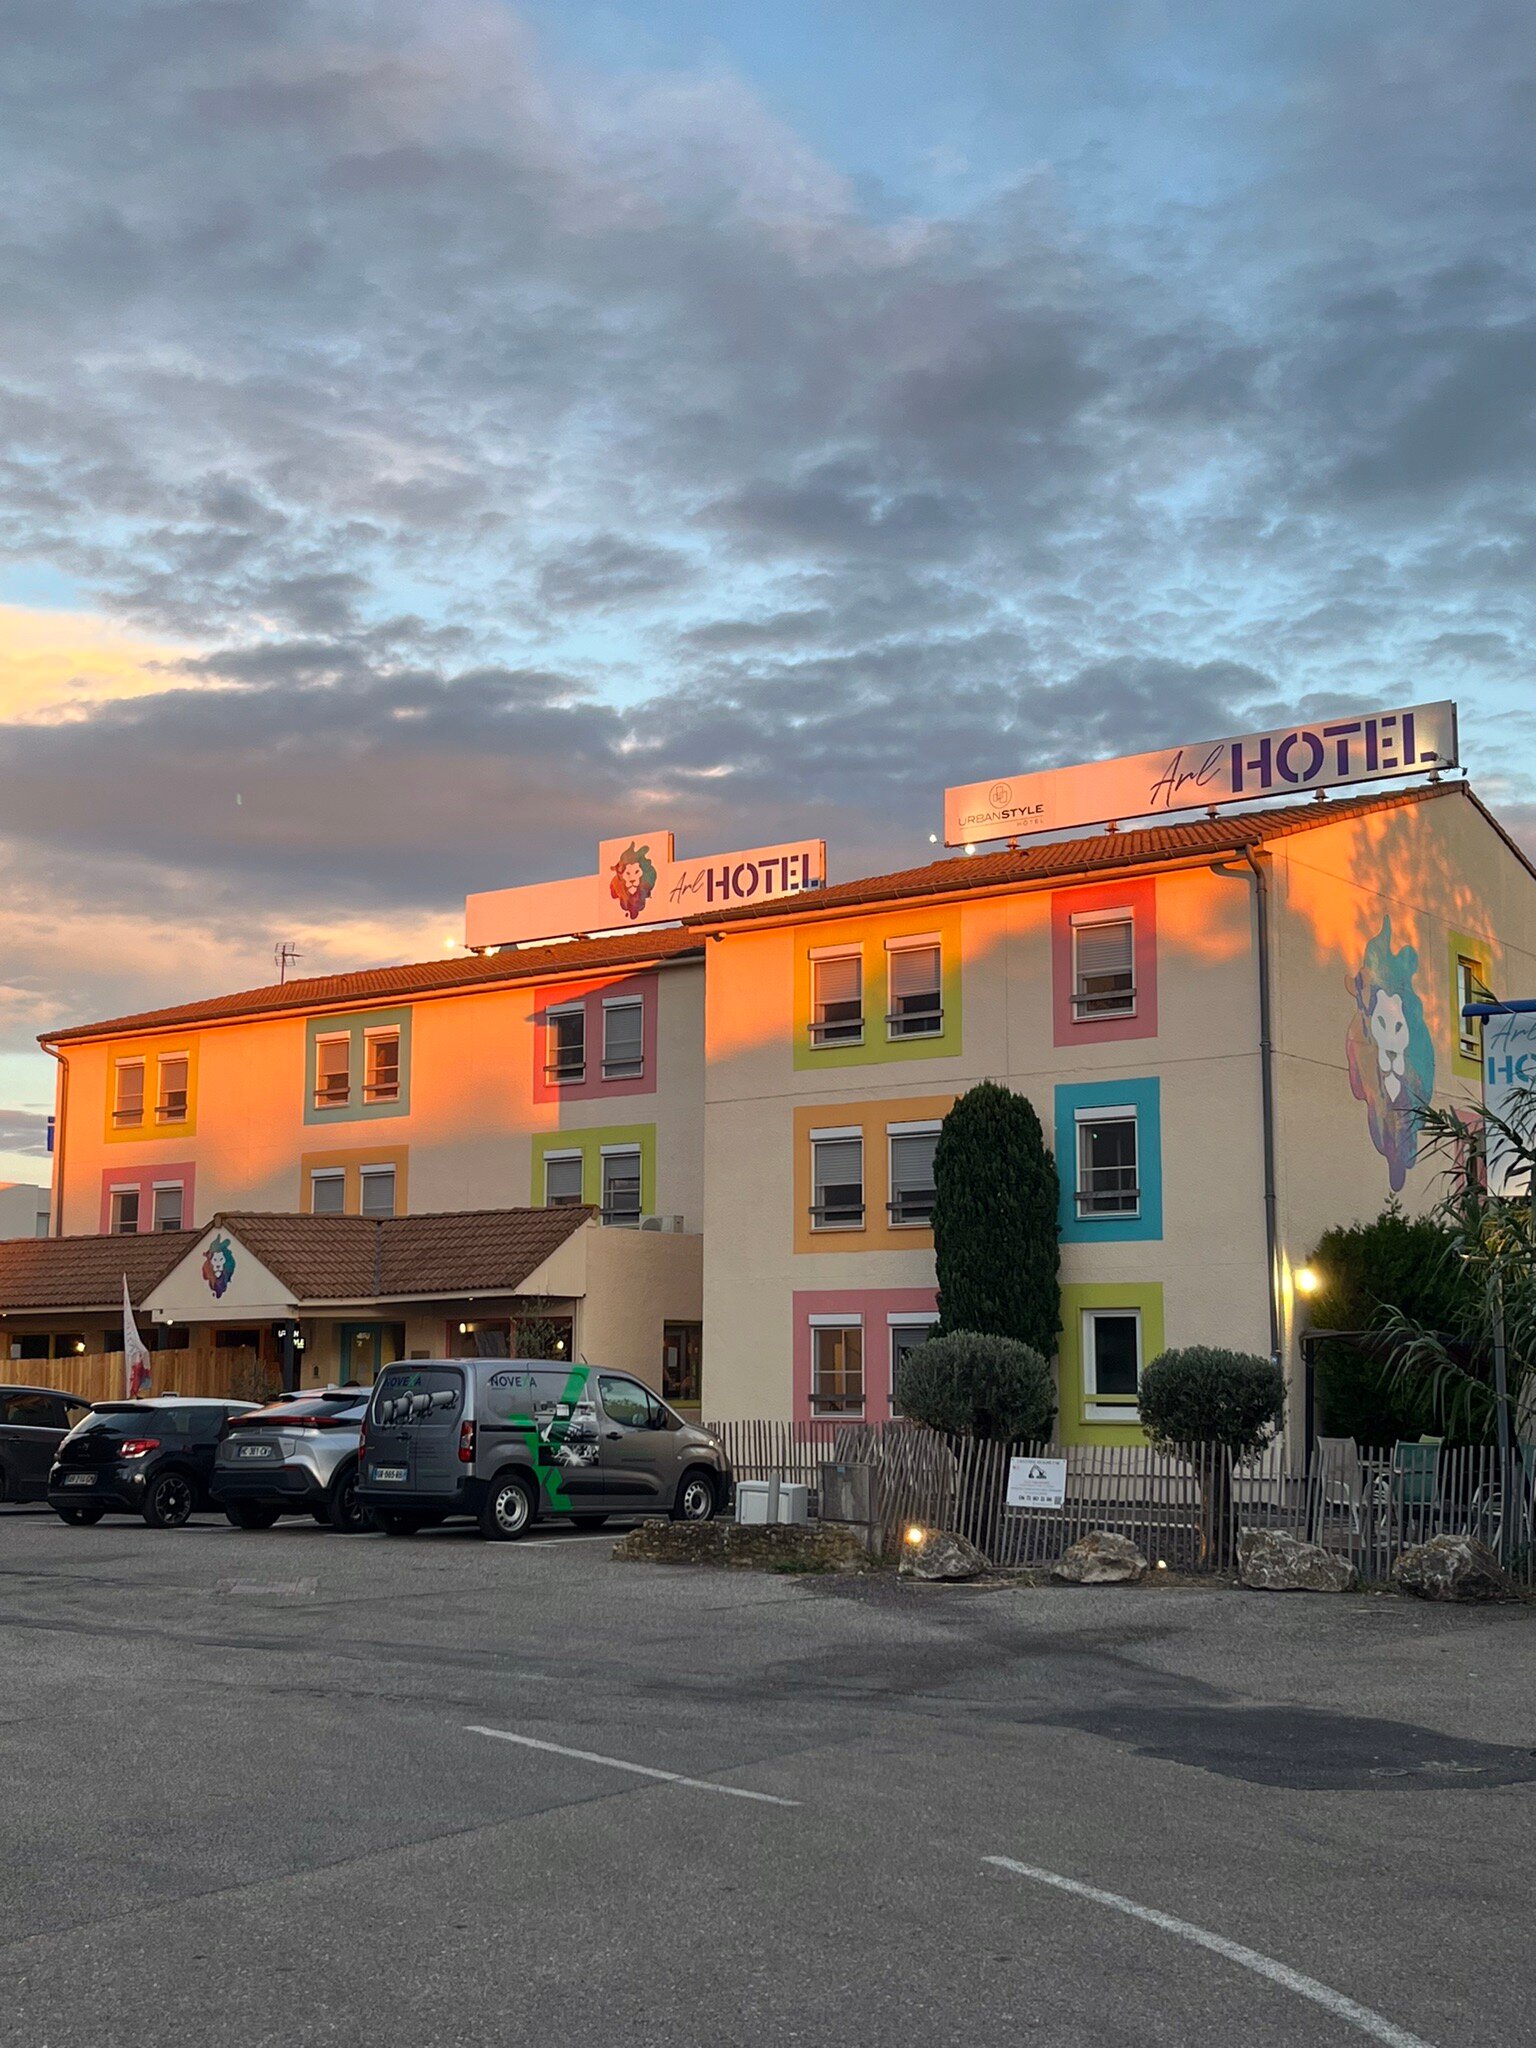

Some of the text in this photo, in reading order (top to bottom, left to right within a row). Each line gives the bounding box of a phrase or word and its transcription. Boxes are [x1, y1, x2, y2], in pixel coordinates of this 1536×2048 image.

[1231, 713, 1436, 793] HOTEL
[958, 804, 1044, 826] URBANSTYLE
[707, 853, 819, 902] HOTEL
